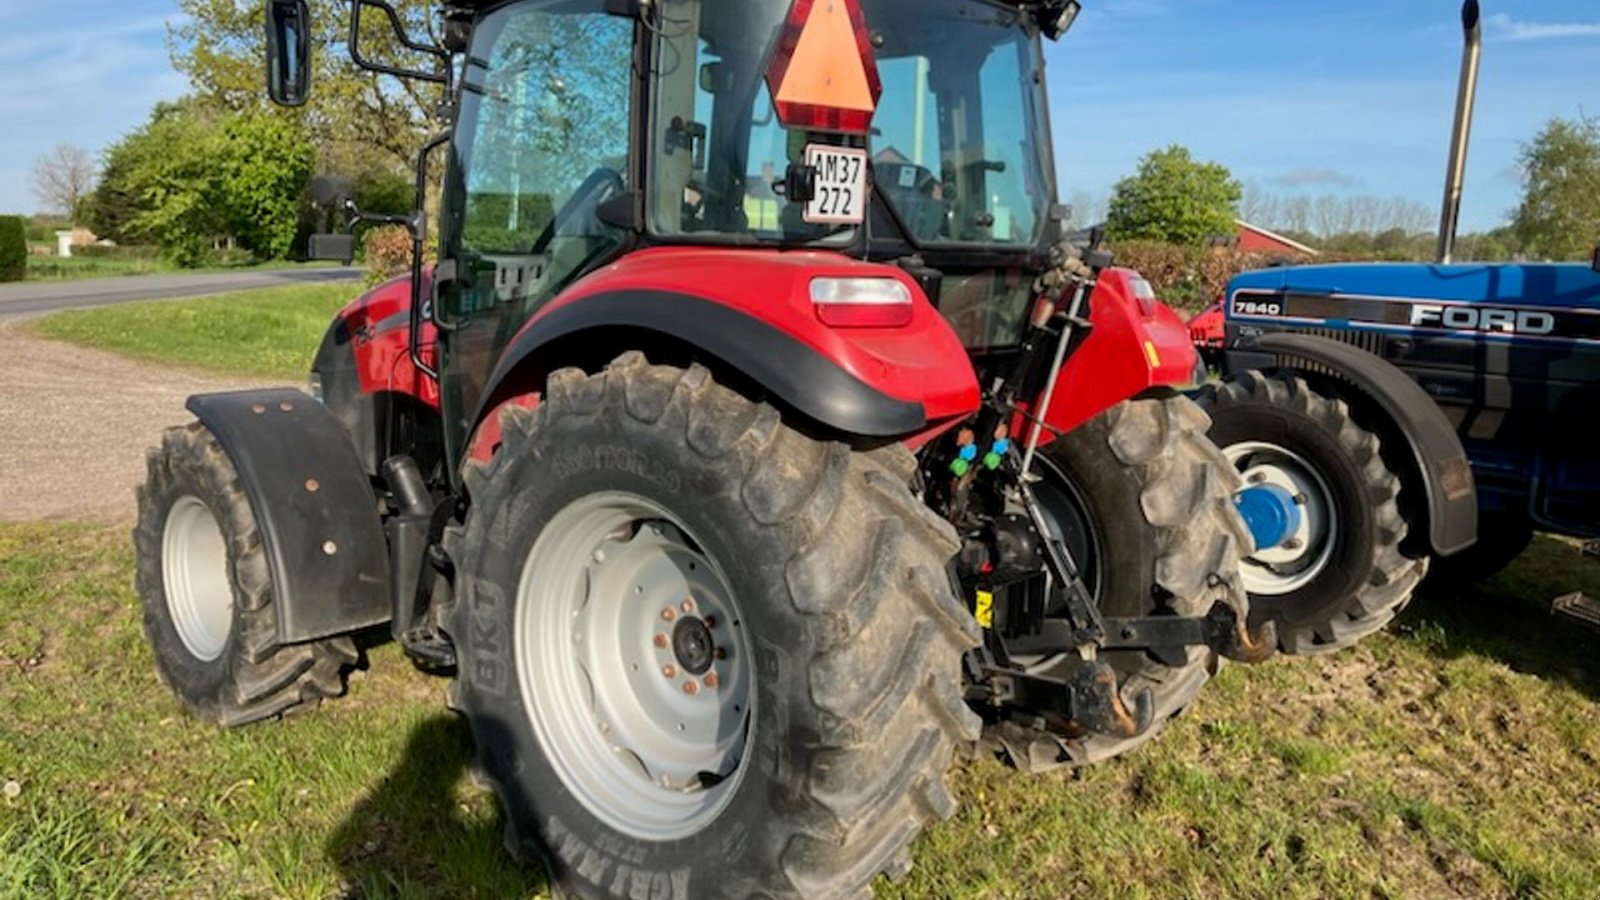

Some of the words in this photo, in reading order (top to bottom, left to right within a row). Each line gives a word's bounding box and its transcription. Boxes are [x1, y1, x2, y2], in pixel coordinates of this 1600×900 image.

[815, 153, 861, 184] AM37
[819, 186, 852, 215] 272
[1235, 301, 1280, 315] 7840
[1410, 304, 1555, 334] FORD
[470, 580, 501, 692] BKT
